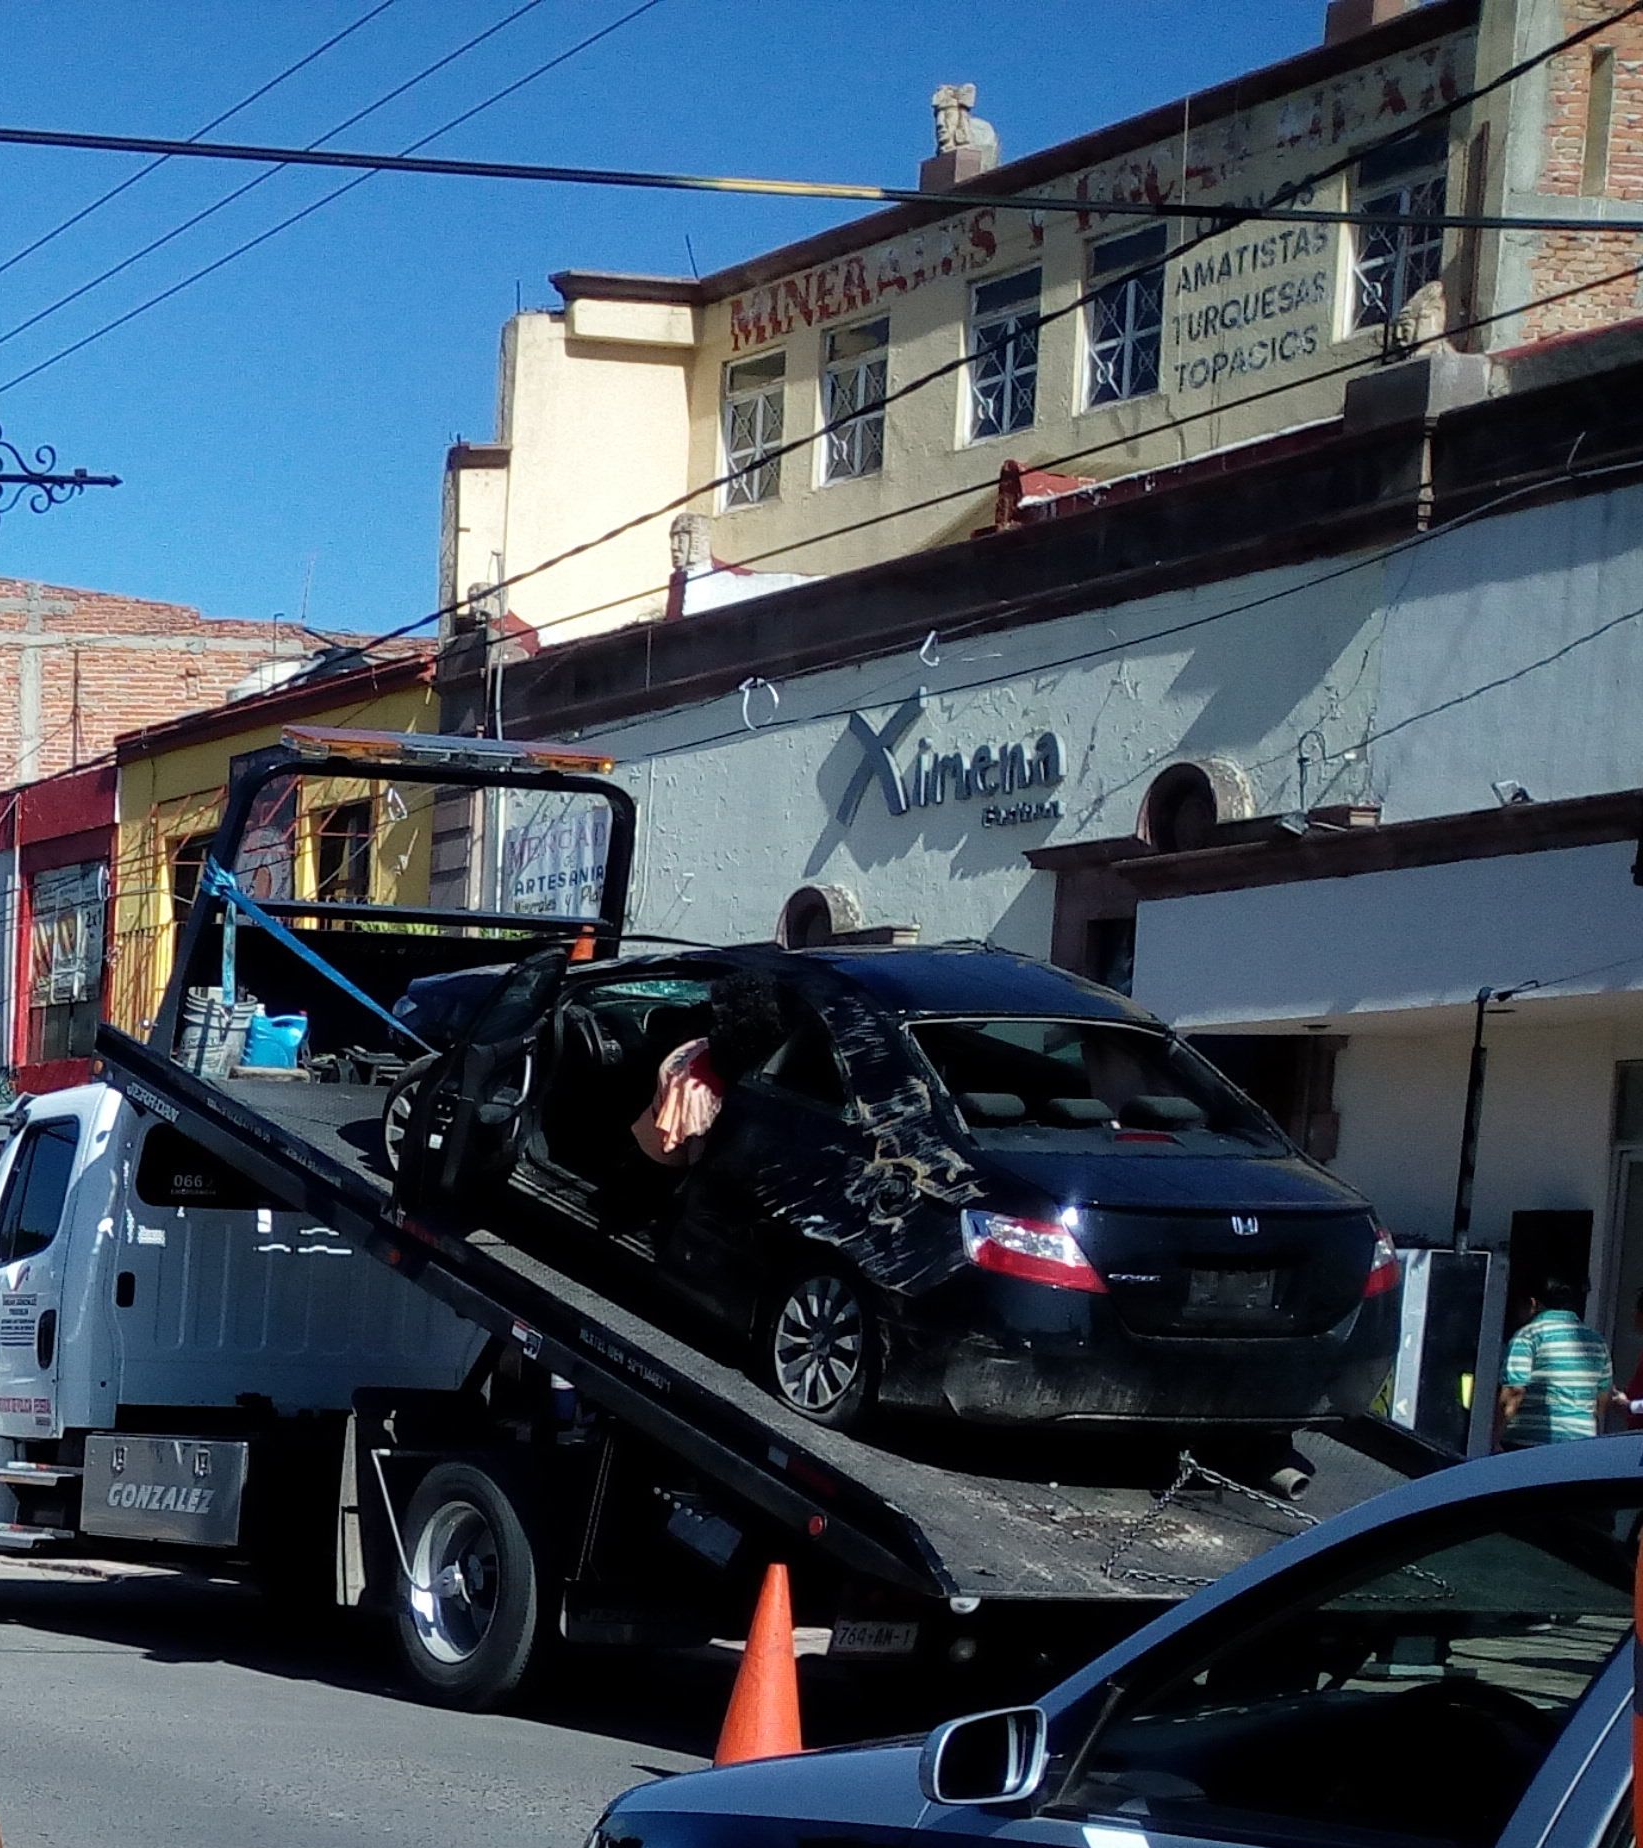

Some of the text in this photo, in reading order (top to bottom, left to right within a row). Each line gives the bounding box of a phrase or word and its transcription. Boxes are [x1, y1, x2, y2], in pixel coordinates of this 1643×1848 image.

[1175, 221, 1328, 297] AMATISTAS
[1172, 270, 1327, 345] TURQUESAS
[1174, 324, 1318, 393] TOPACIOS
[836, 686, 1066, 827] Ximena
[173, 1173, 203, 1188] 066
[107, 1482, 215, 1514] GONZALEZ
